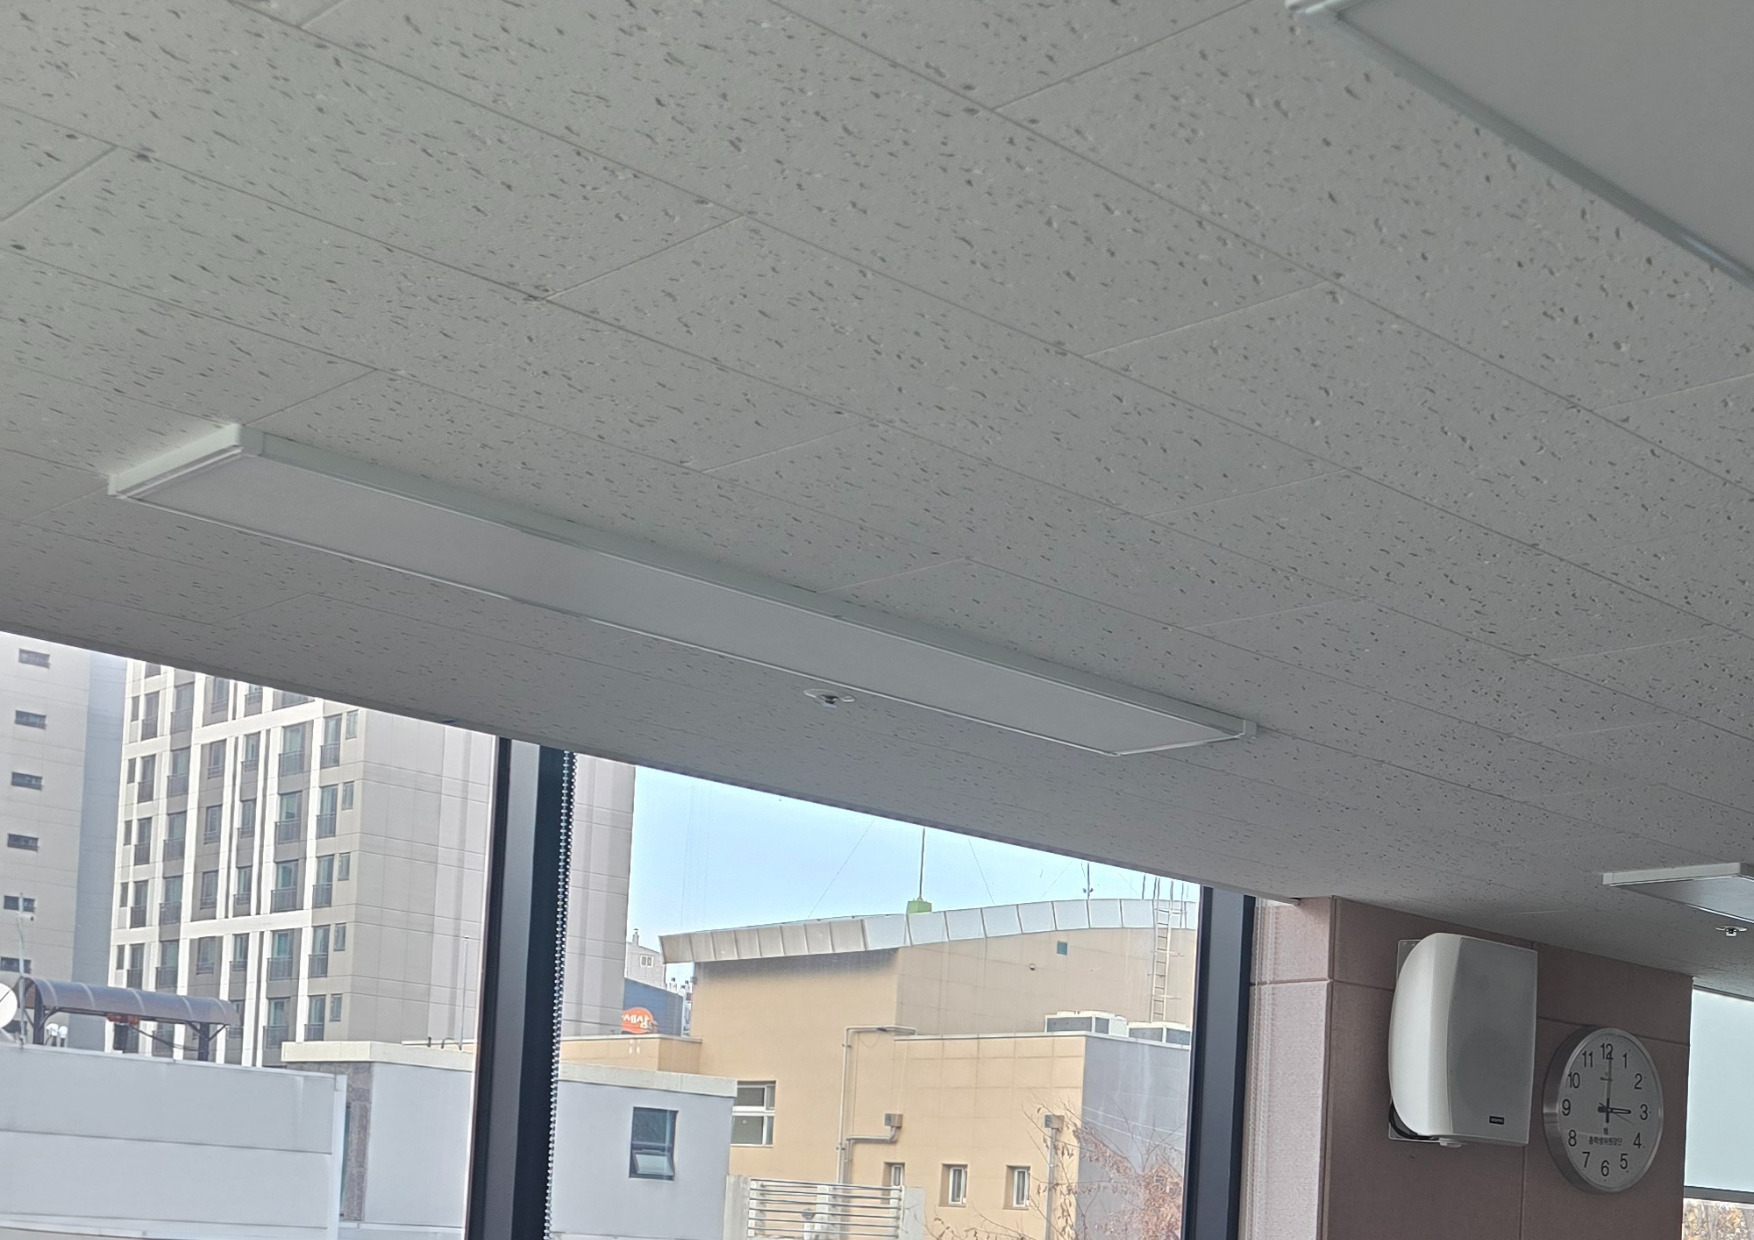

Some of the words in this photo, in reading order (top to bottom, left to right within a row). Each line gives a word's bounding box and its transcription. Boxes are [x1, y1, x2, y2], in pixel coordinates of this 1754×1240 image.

[1582, 1051, 1594, 1067] 11
[1600, 1043, 1614, 1060] 12
[1622, 1052, 1628, 1069] 1
[1567, 1071, 1581, 1089] 10
[1634, 1073, 1642, 1090] 2
[1562, 1098, 1571, 1116] 9
[1640, 1104, 1648, 1120] 3
[1568, 1129, 1577, 1147] 8
[1633, 1132, 1642, 1148] 4
[1582, 1151, 1591, 1168] 7
[1601, 1159, 1610, 1176] 6
[1620, 1153, 1628, 1169] 5
